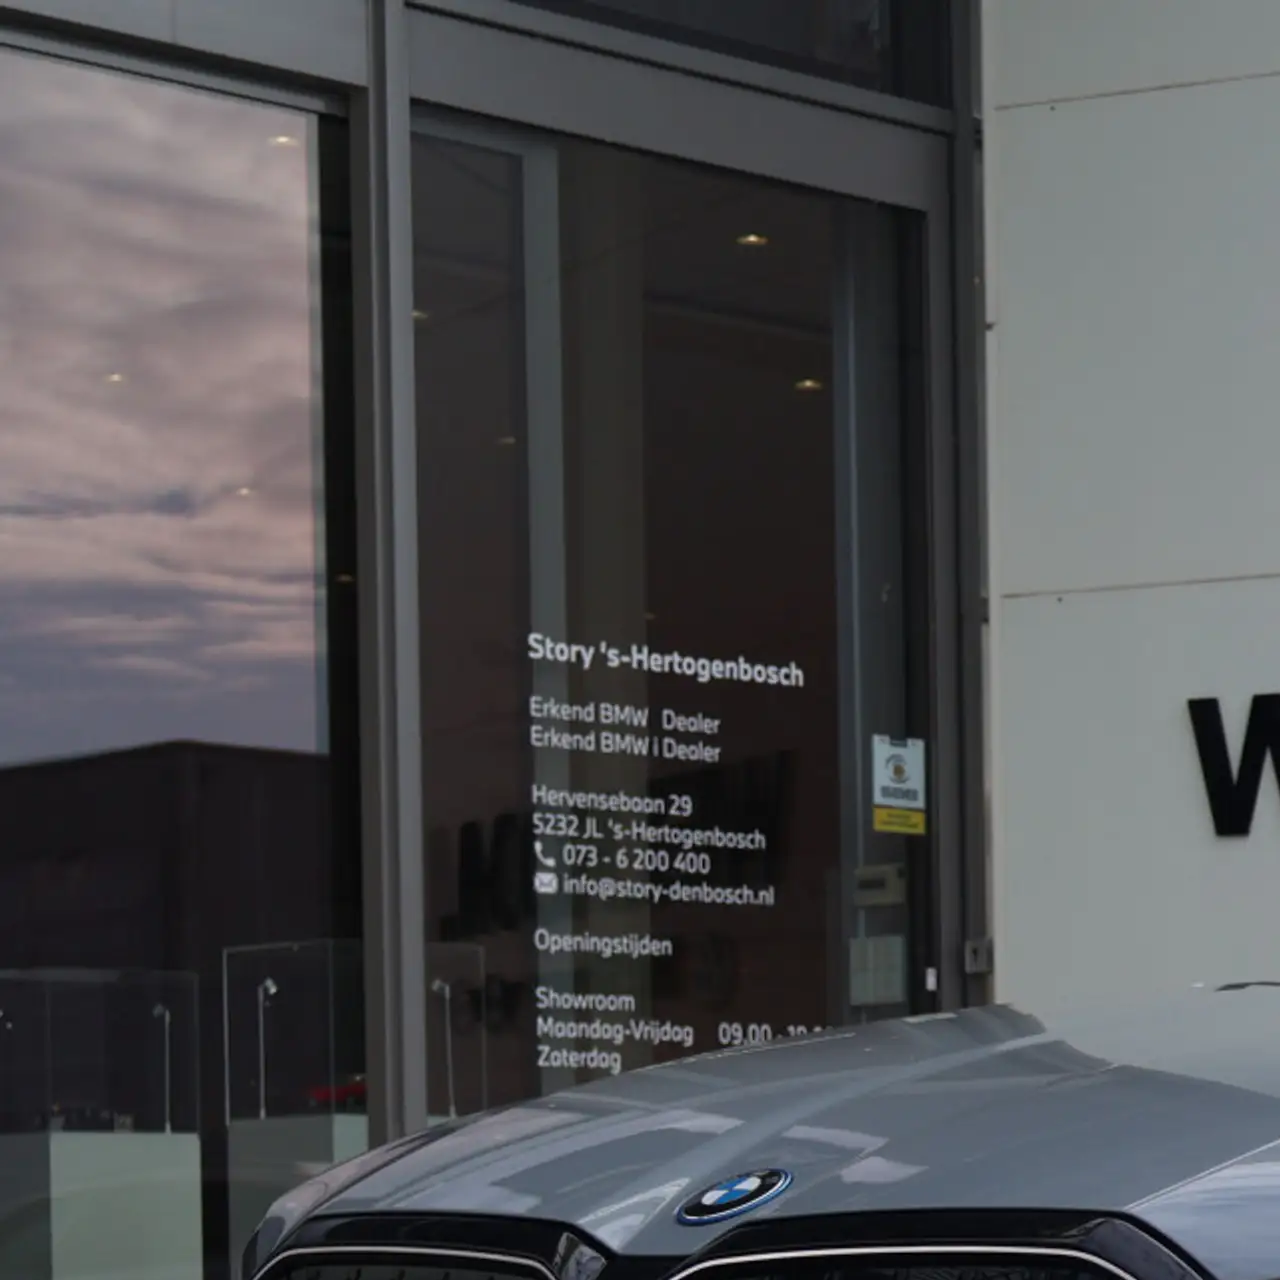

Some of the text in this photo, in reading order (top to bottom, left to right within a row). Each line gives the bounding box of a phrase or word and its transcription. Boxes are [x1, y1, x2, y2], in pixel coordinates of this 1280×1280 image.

[527, 632, 804, 687] Story 's-Hertogenbosch
[529, 695, 721, 735] Erkend BMW Dealer
[530, 724, 596, 752] Erkend
[600, 731, 650, 756] BMW
[662, 737, 721, 763] Dealer
[531, 784, 693, 817] Hervensebaan 29
[532, 813, 579, 837] 5232
[582, 817, 604, 839] JL
[562, 843, 598, 867] 073
[616, 847, 629, 869] 6
[632, 849, 669, 872] 200
[674, 852, 710, 873] 400
[564, 873, 775, 905] info@story-denbosch.nl
[533, 927, 673, 959] Openingstijden
[535, 986, 636, 1011] Showroom
[537, 1016, 694, 1047] Maandag-Vrijdag
[718, 1022, 772, 1045] 09.00
[537, 1046, 621, 1075] Zaterdag
